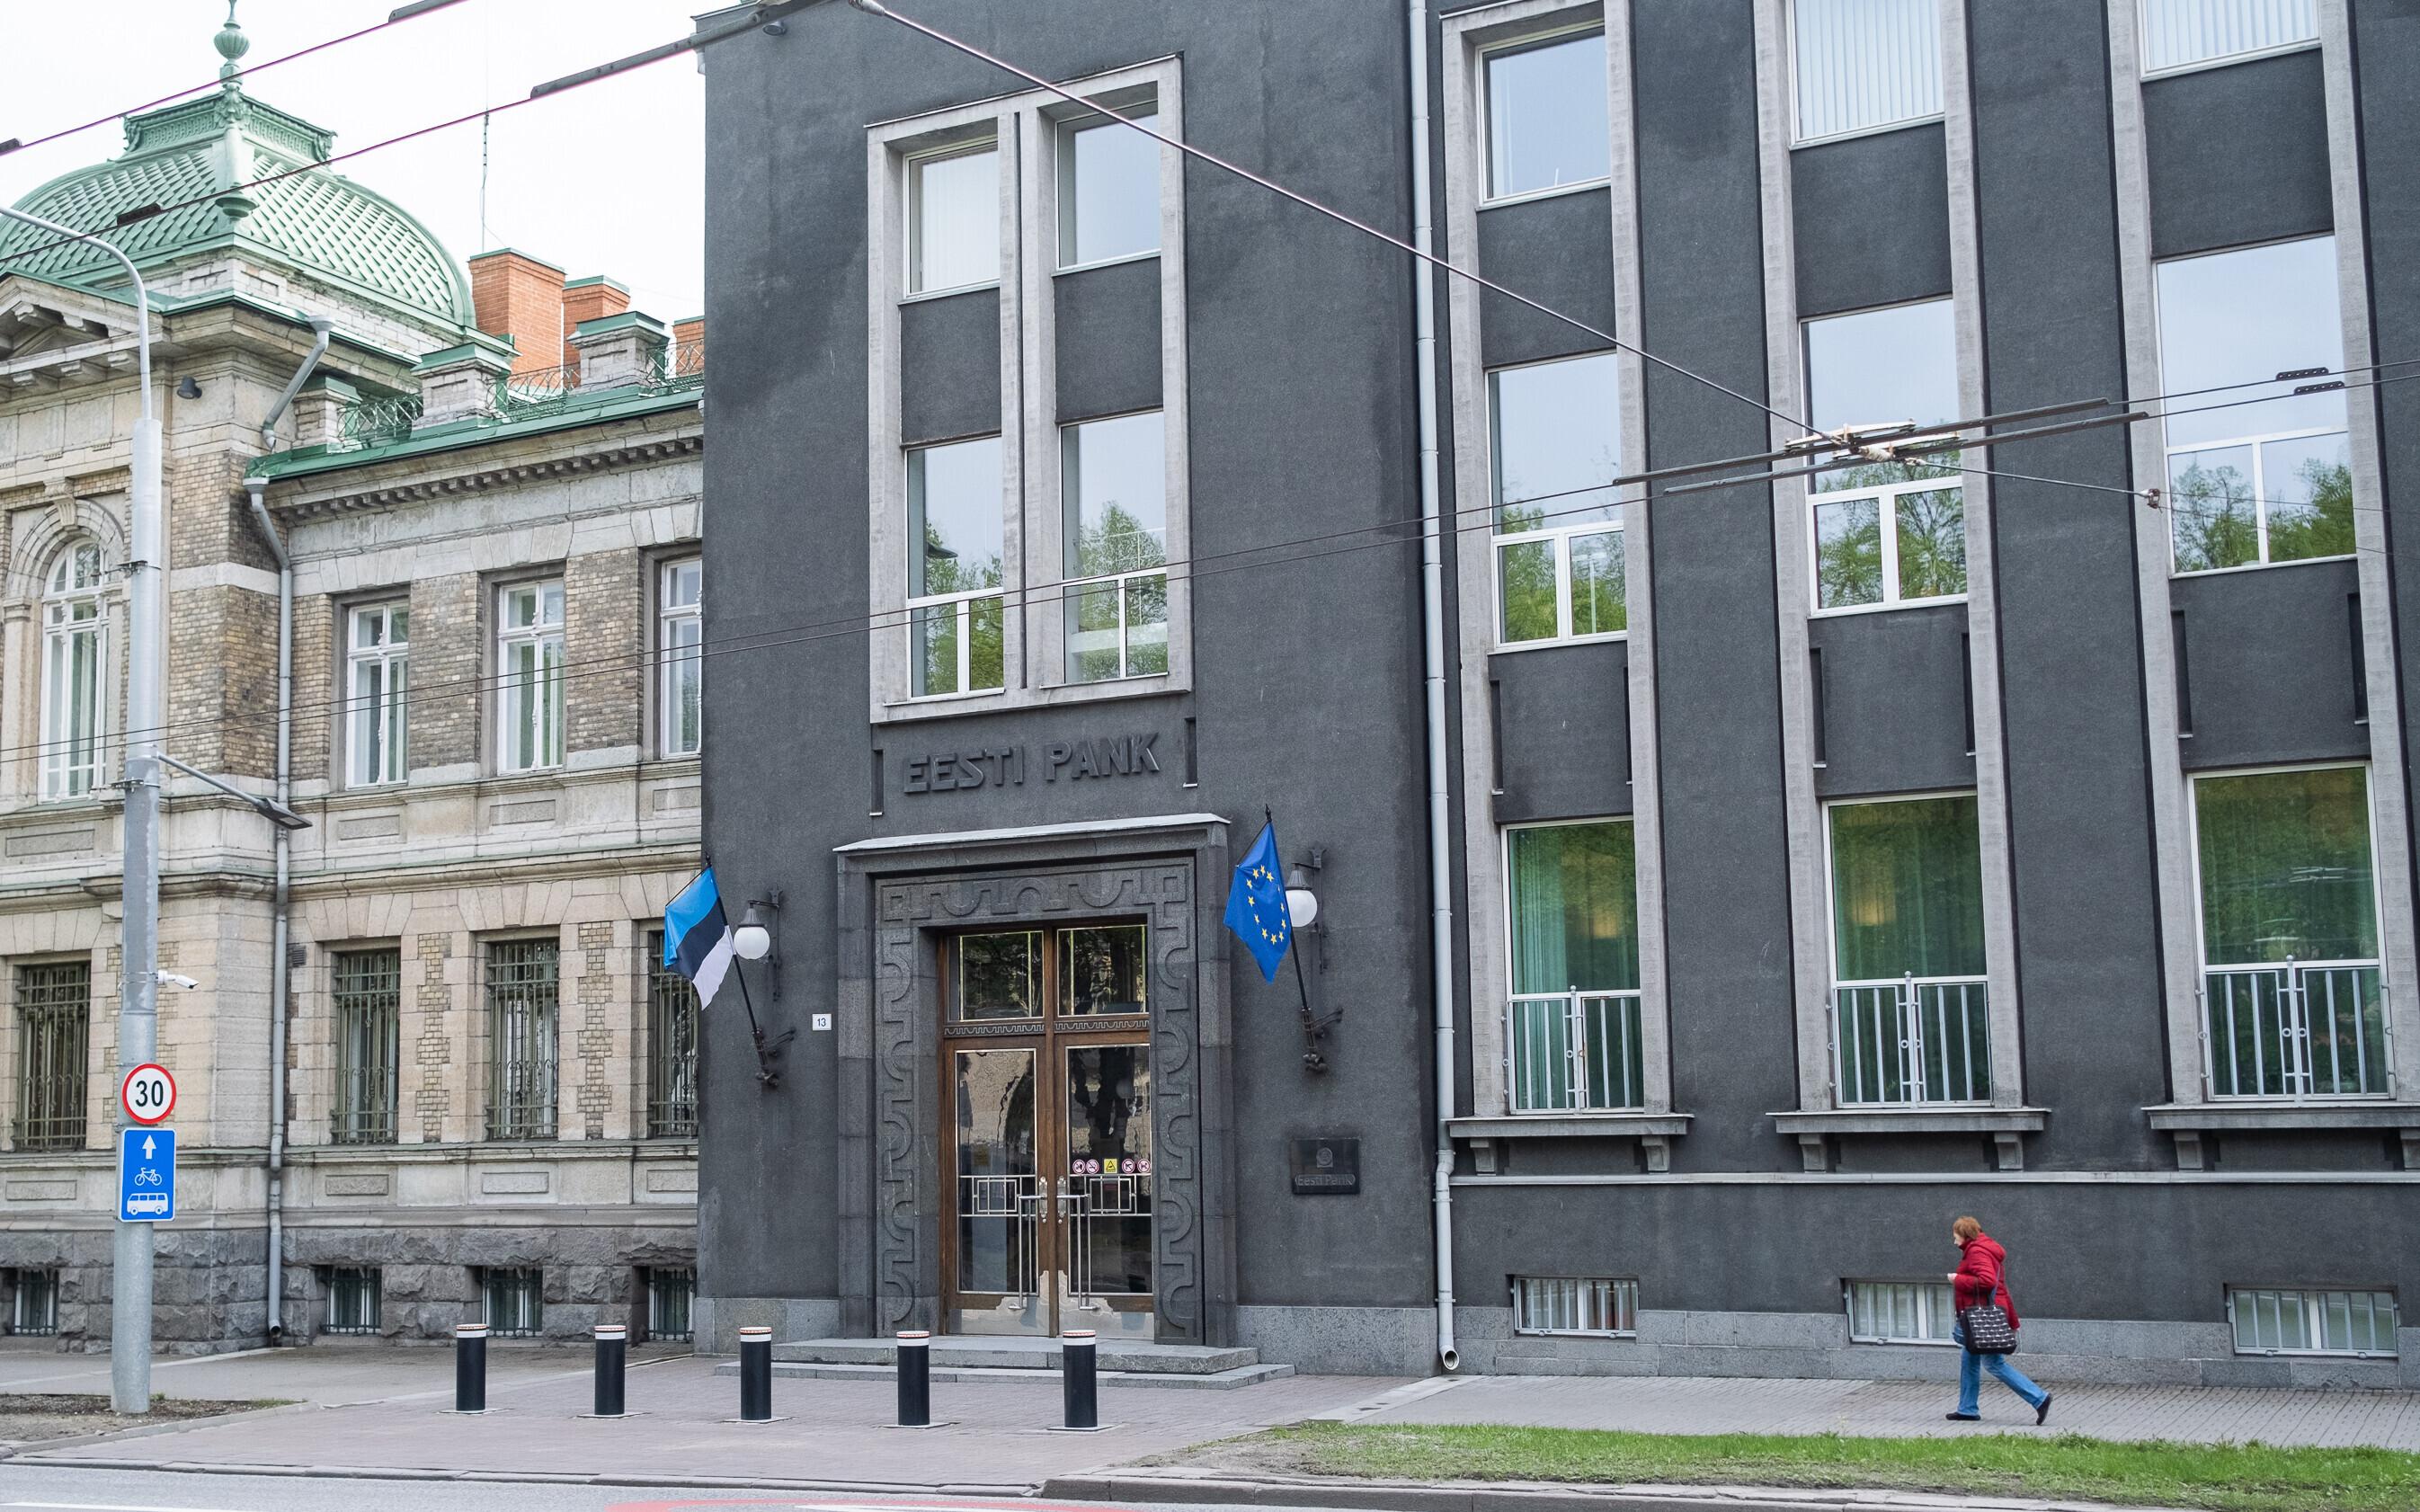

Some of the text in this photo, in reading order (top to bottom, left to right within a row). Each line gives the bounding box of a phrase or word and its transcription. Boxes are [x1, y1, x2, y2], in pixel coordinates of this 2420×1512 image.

[903, 732, 1160, 794] EESTI PANK
[817, 1018, 826, 1027] 13
[136, 1081, 164, 1107] 30
